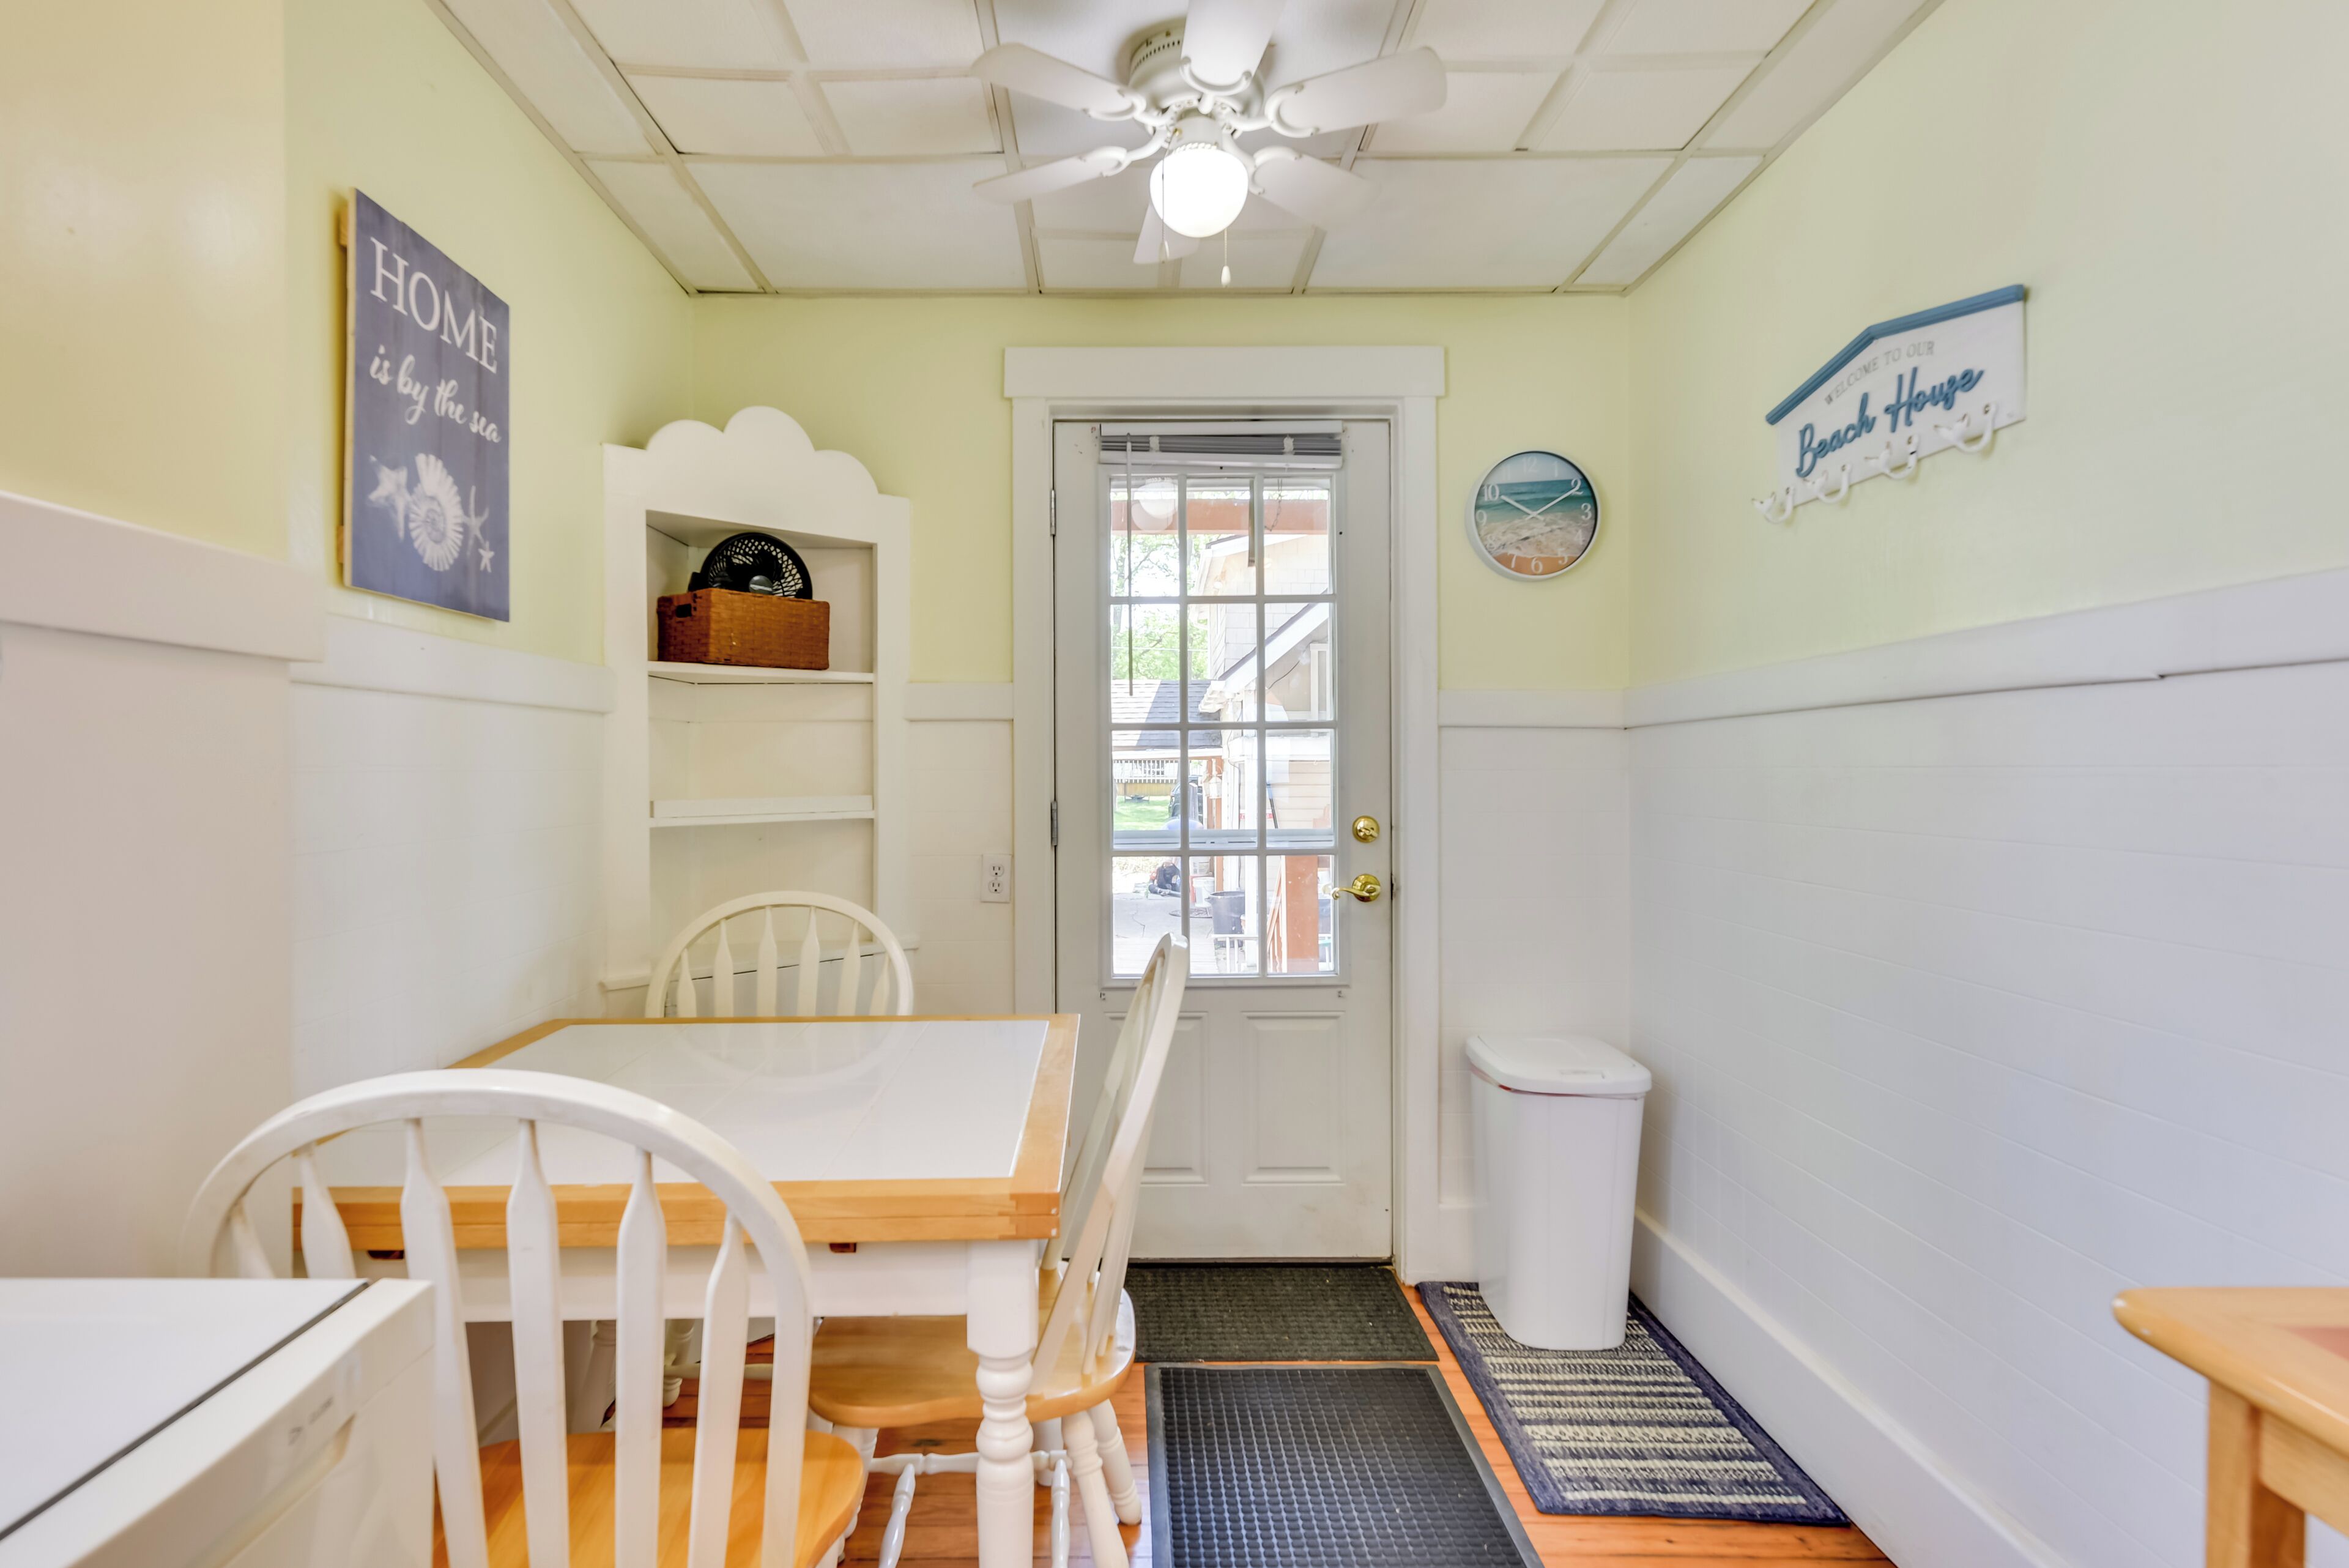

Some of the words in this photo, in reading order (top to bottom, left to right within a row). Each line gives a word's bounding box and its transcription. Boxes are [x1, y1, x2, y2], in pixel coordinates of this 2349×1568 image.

[370, 236, 497, 374] HOME
[1824, 357, 1879, 405] WELCOME
[1883, 348, 1901, 365] TO
[1906, 340, 1934, 357] OUR
[369, 344, 393, 385] is
[397, 354, 429, 425] by
[434, 379, 467, 424] the
[469, 411, 502, 443] sea
[1796, 392, 1876, 477] Beach
[1884, 366, 1984, 433] House
[1483, 484, 1499, 500] 10
[1571, 478, 1583, 495] 2
[1475, 510, 1487, 526] 9
[1581, 503, 1592, 520] 3
[1574, 529, 1583, 544] 4
[1507, 552, 1517, 568] 7
[1557, 548, 1568, 565] 5
[1531, 557, 1543, 574] 6
